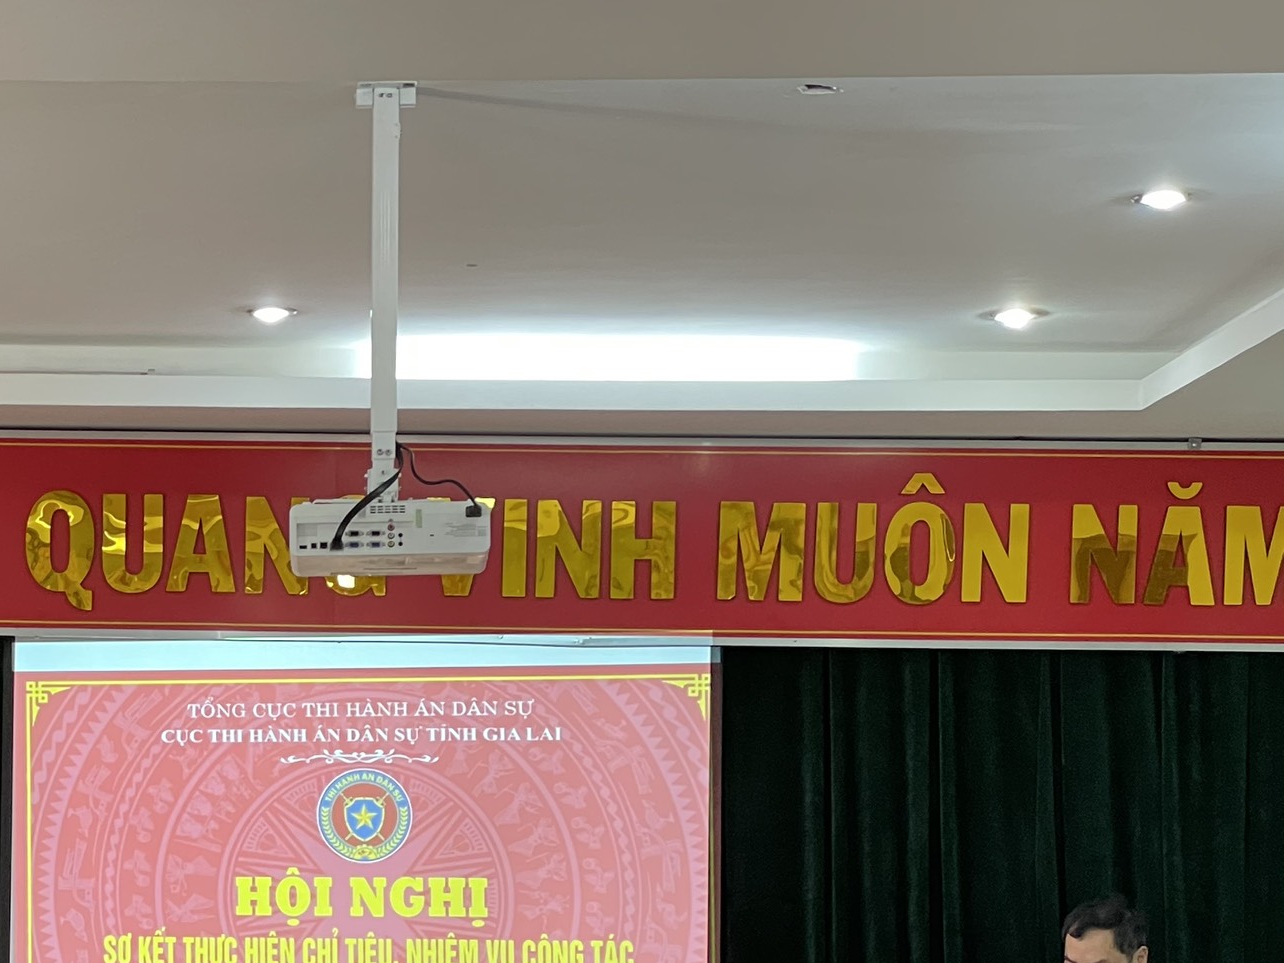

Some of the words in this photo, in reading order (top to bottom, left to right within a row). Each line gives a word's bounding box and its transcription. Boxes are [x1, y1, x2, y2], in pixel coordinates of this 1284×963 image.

[24, 490, 387, 612] QUAN
[717, 473, 1031, 606] MUÔN
[1069, 481, 1284, 607] NĂM
[187, 697, 246, 718] TỔNG
[252, 702, 296, 720] CỤC
[302, 702, 338, 717] THI
[346, 698, 408, 717] HÀNH
[413, 697, 445, 717] ÁN
[452, 698, 499, 716] DÂN
[504, 698, 535, 719] SỰ
[161, 729, 203, 747] CỤC
[208, 729, 243, 743] THI
[249, 725, 307, 743] HÀNH
[313, 725, 340, 743] ÁN
[346, 725, 389, 743] DÂN
[394, 726, 423, 745] SỰ
[483, 727, 522, 742] GIA
[527, 727, 562, 742] LAI
[235, 867, 333, 926] HỘI
[349, 877, 489, 928] NGHỊ
